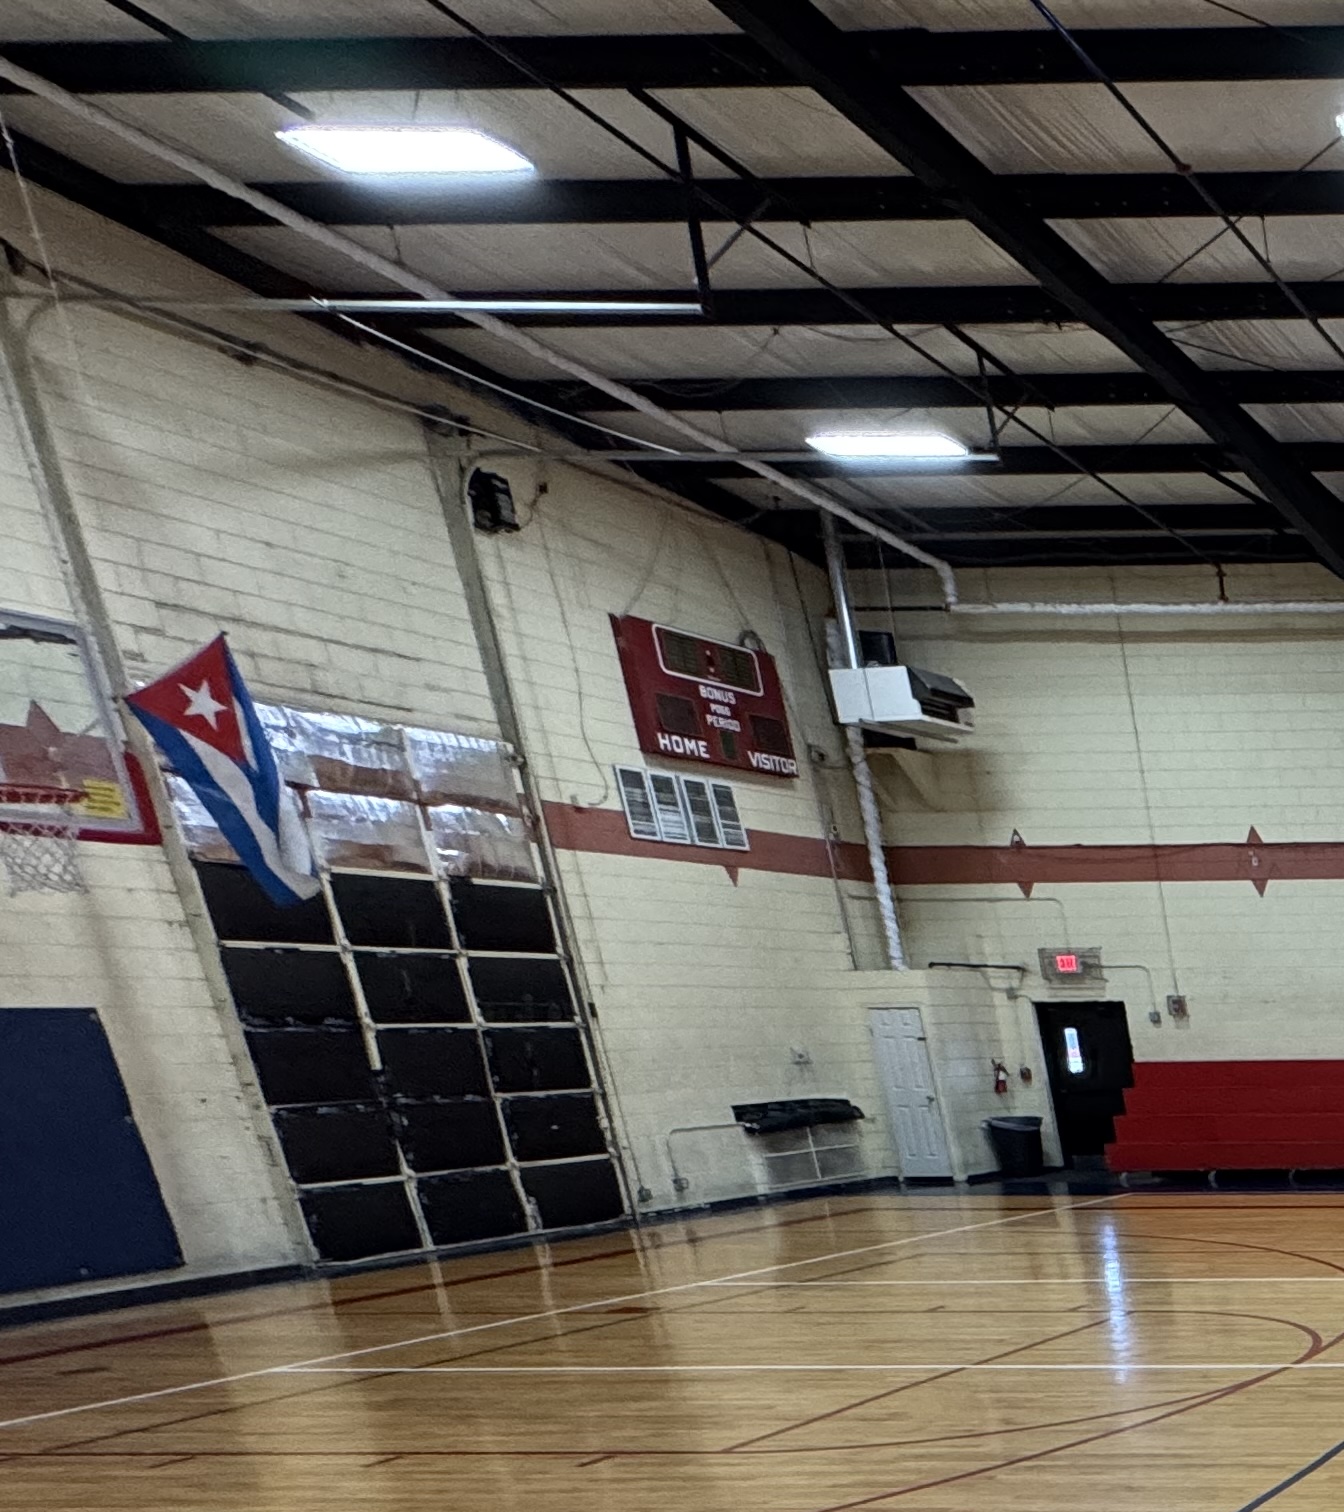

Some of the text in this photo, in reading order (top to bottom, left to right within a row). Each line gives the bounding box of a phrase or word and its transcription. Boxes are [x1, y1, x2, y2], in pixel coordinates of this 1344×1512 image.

[699, 684, 737, 704] BONUS
[657, 732, 710, 758] HOME
[747, 751, 798, 775] VISITOR
